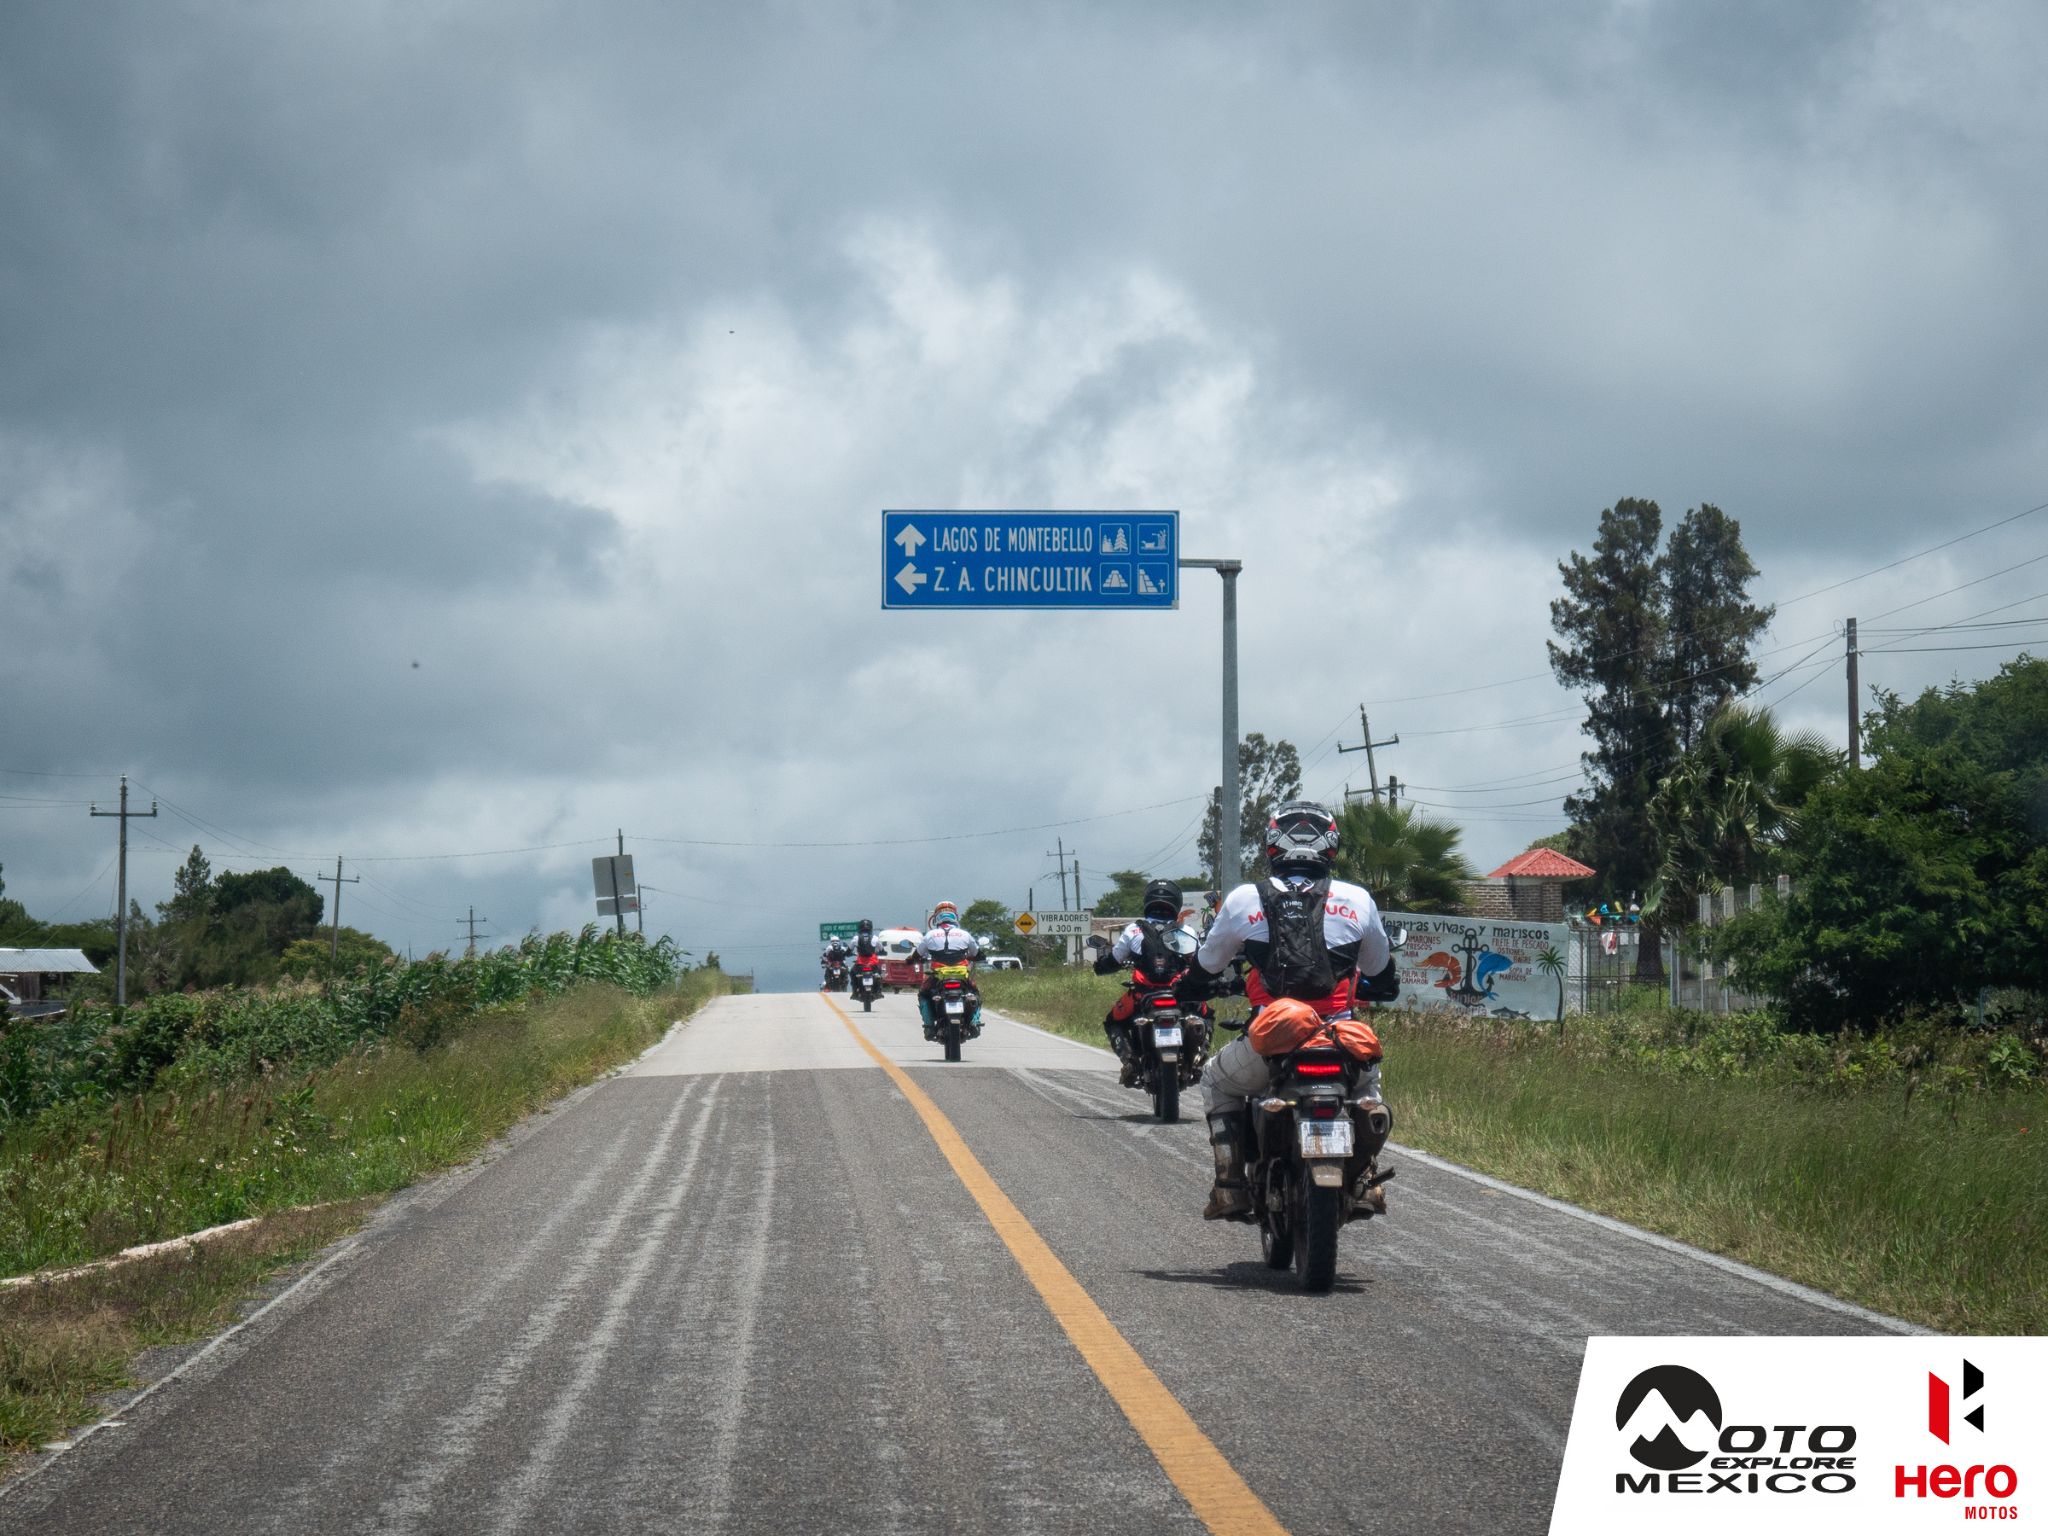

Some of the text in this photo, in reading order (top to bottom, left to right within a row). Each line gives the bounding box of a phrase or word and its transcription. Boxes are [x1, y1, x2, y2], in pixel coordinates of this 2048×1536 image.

[933, 526, 1093, 553] LAGOS DE MONTEBELLO
[934, 566, 1093, 592] Z. A. CHINCULTIK
[1040, 913, 1089, 922] VIBRADORES
[1047, 925, 1053, 933] A
[1056, 925, 1072, 933] 300
[1433, 920, 1466, 935] vivas
[1478, 925, 1487, 936] y
[1492, 926, 1550, 940] mariscos
[1407, 935, 1441, 945] AMARONES
[1492, 938, 1549, 950] FILETE DE PESCADO
[1406, 943, 1433, 951] FRESCOS
[1402, 970, 1419, 978] PULPA
[1509, 967, 1532, 975] SOPA DE
[1499, 974, 1527, 982] MARISCOS
